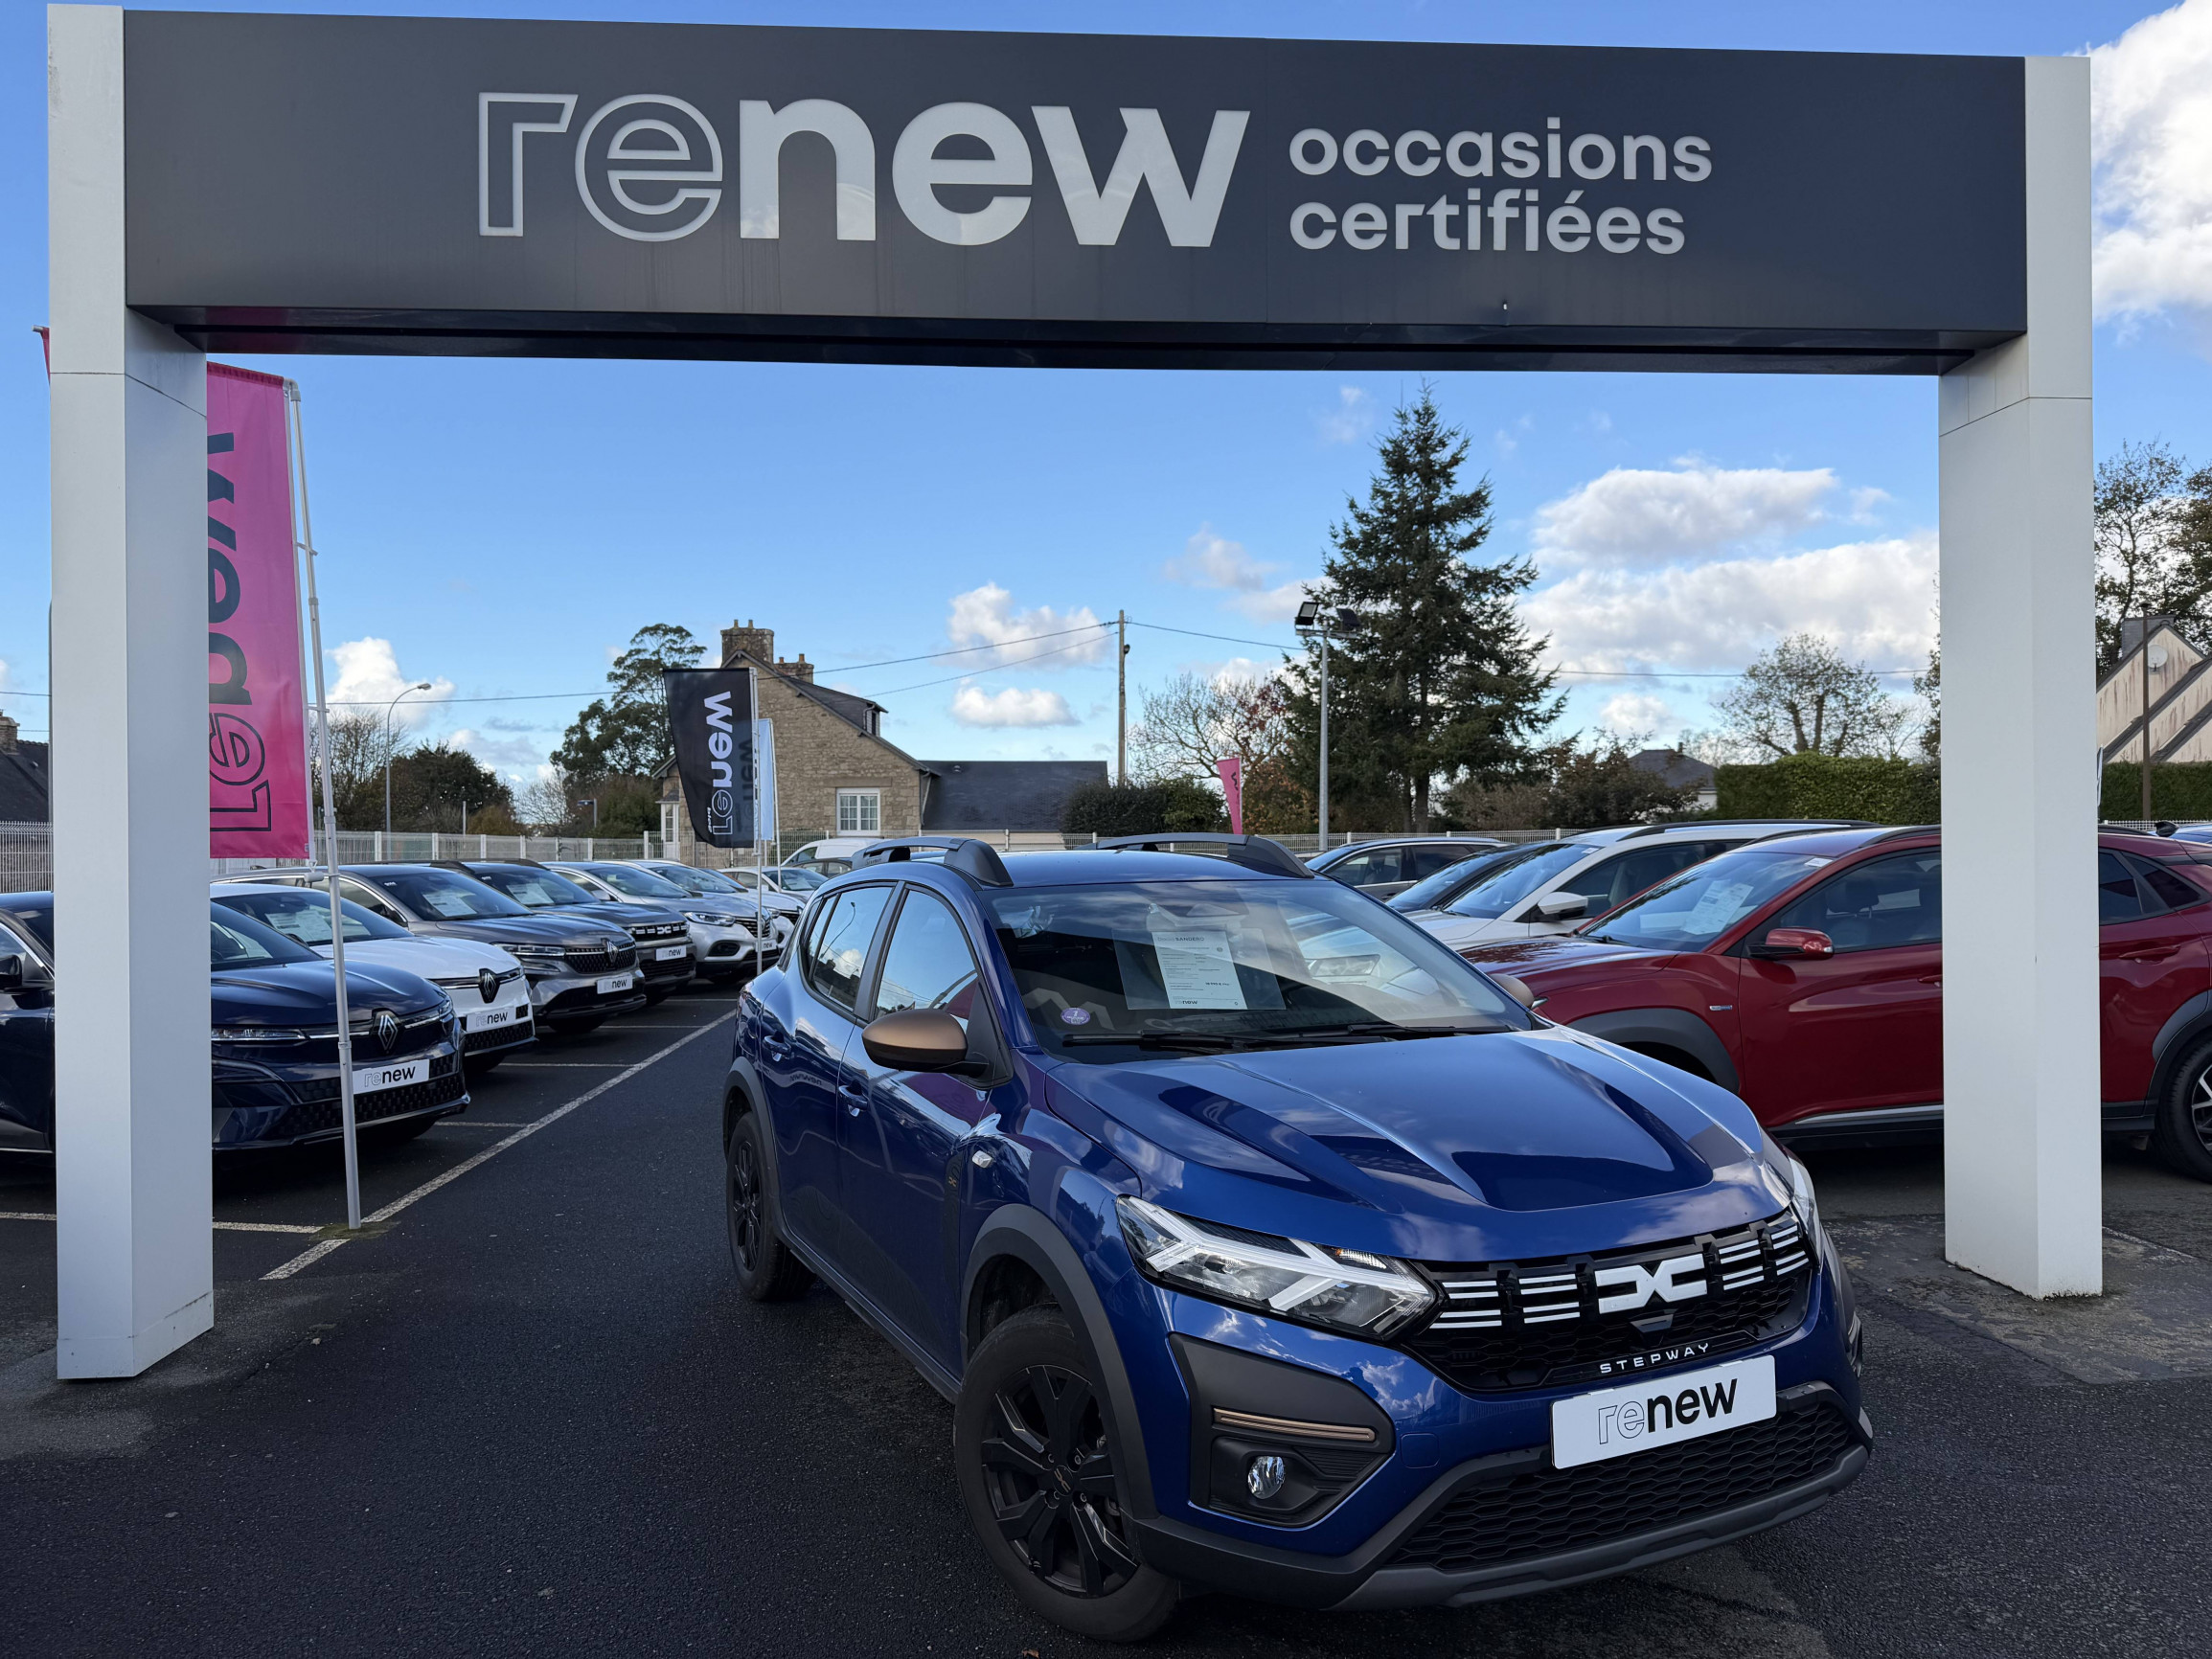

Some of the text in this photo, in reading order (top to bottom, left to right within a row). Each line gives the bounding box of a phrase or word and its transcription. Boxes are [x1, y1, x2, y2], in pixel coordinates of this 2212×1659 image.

[478, 91, 1252, 247] renew
[1289, 116, 1713, 182] occasions
[1289, 187, 1686, 254] certifiées
[364, 1066, 416, 1087] renew
[1599, 1342, 1711, 1375] STEPWAY
[1597, 1378, 1738, 1445] renew
